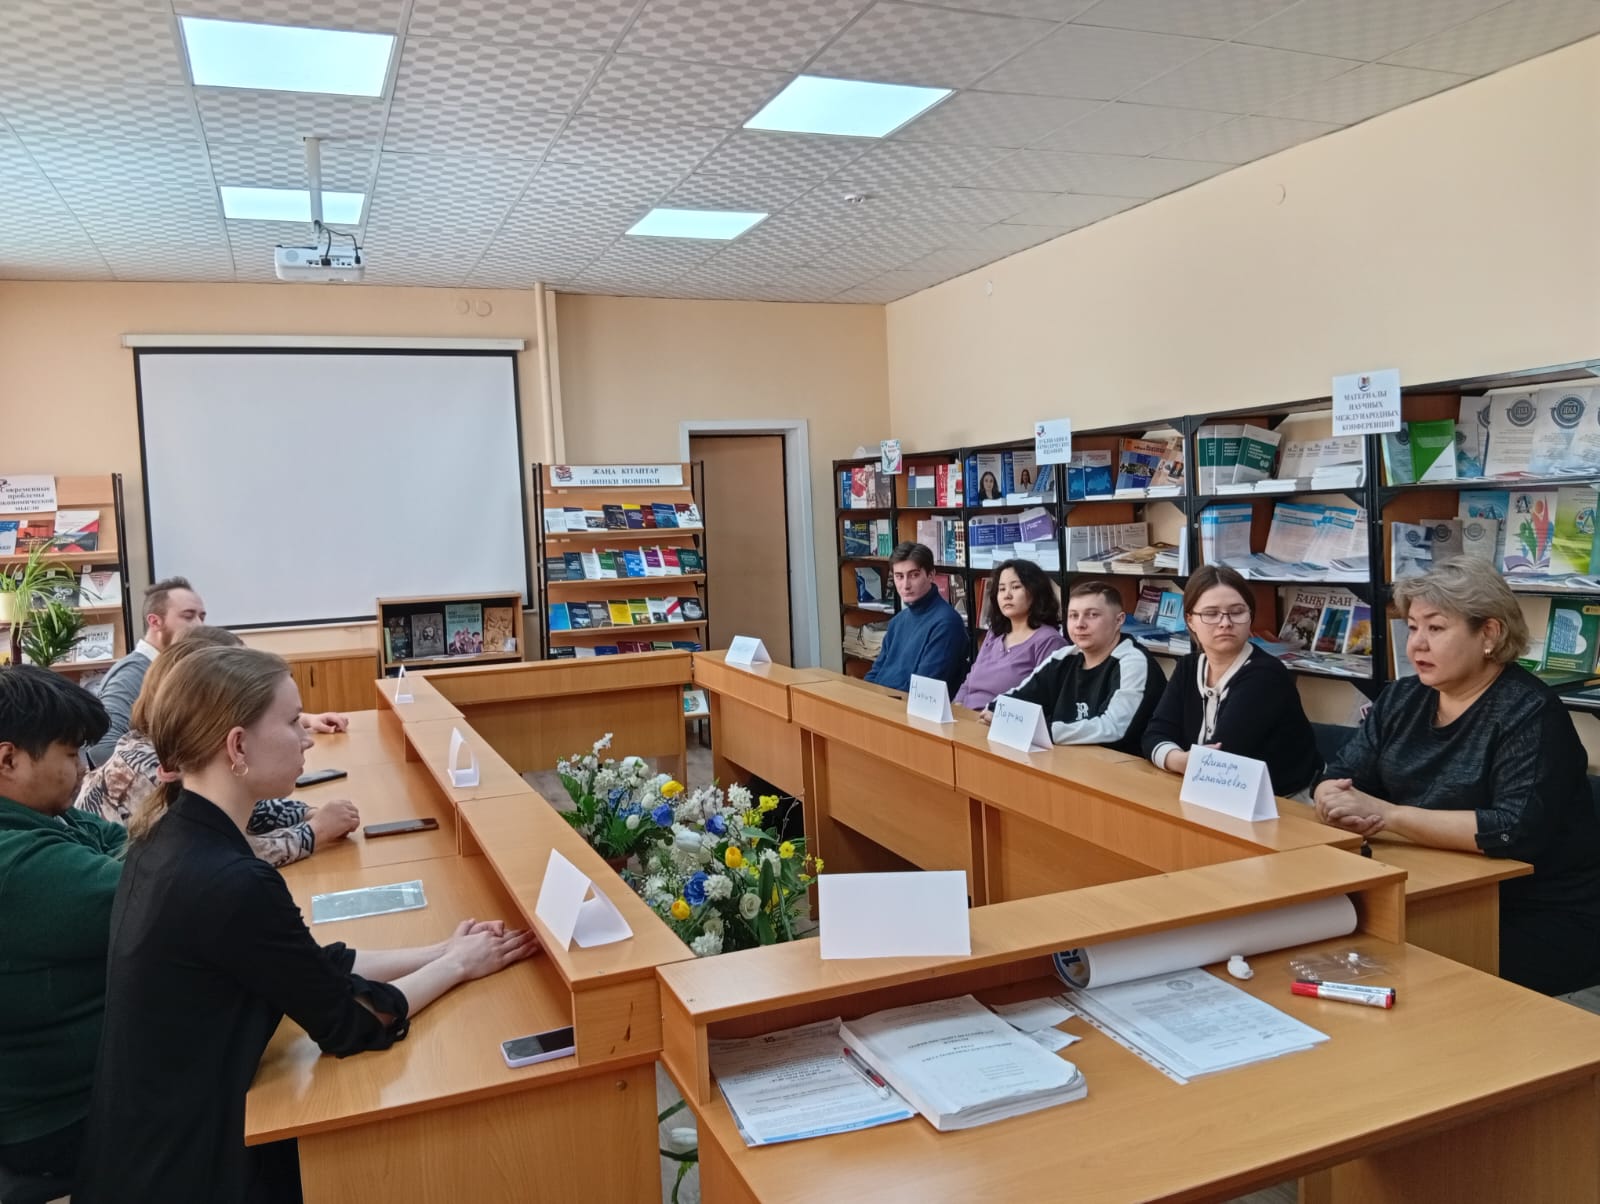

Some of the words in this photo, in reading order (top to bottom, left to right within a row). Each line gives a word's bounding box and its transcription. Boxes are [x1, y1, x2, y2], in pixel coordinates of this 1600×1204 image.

[1344, 391, 1388, 400] МАТЕРИАЛЫ
[1348, 401, 1384, 411] НАУЧНЫХ
[1335, 410, 1400, 421] МЕЖДУНАРОДНЫХ
[1342, 419, 1395, 431] КОНФЕРЕНЦИЙ
[8, 492, 45, 500] проблемы
